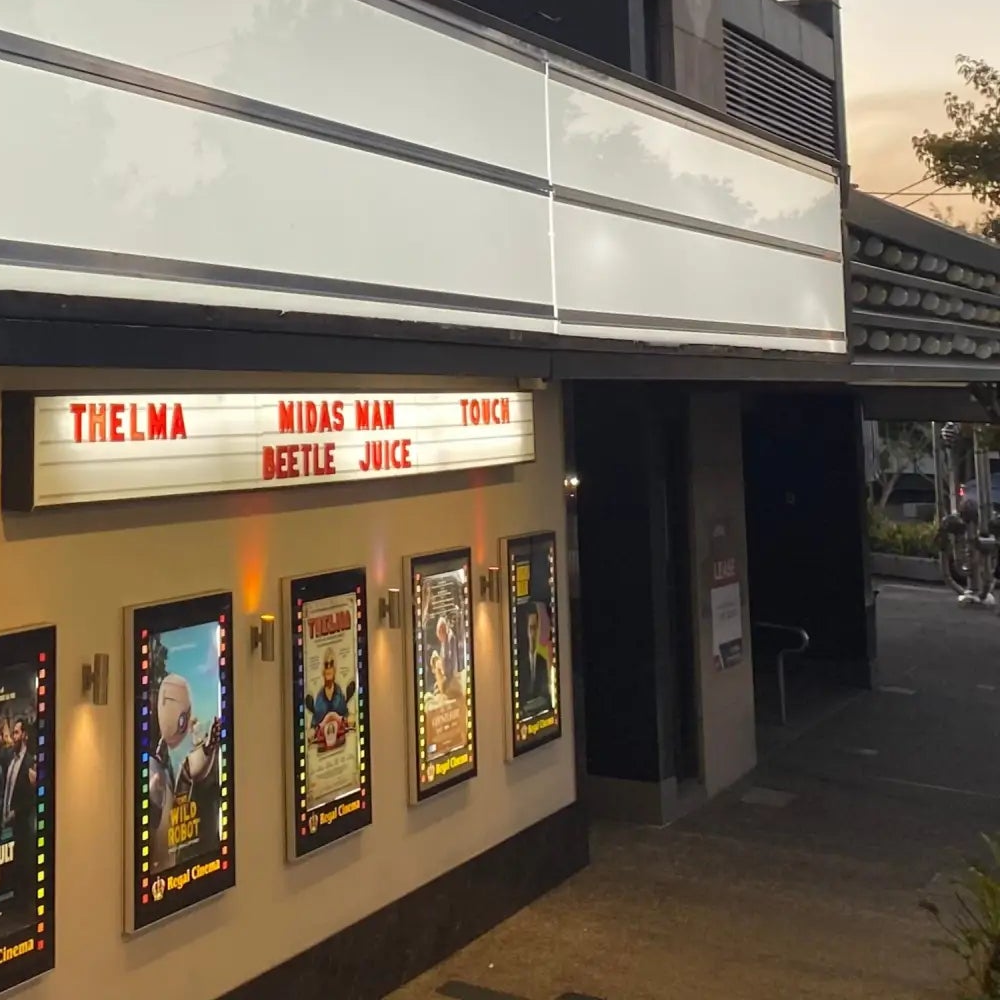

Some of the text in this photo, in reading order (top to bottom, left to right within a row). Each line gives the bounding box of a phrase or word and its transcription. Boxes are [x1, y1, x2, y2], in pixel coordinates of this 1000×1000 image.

[69, 402, 187, 443] THELMA
[278, 400, 395, 434] MIDAS MAN
[460, 398, 510, 427] TOUCH
[262, 438, 412, 480] BEETLE JUICE
[170, 801, 197, 826] WILD
[168, 817, 200, 848] ROBOT
[167, 859, 221, 892] Regal Cinema
